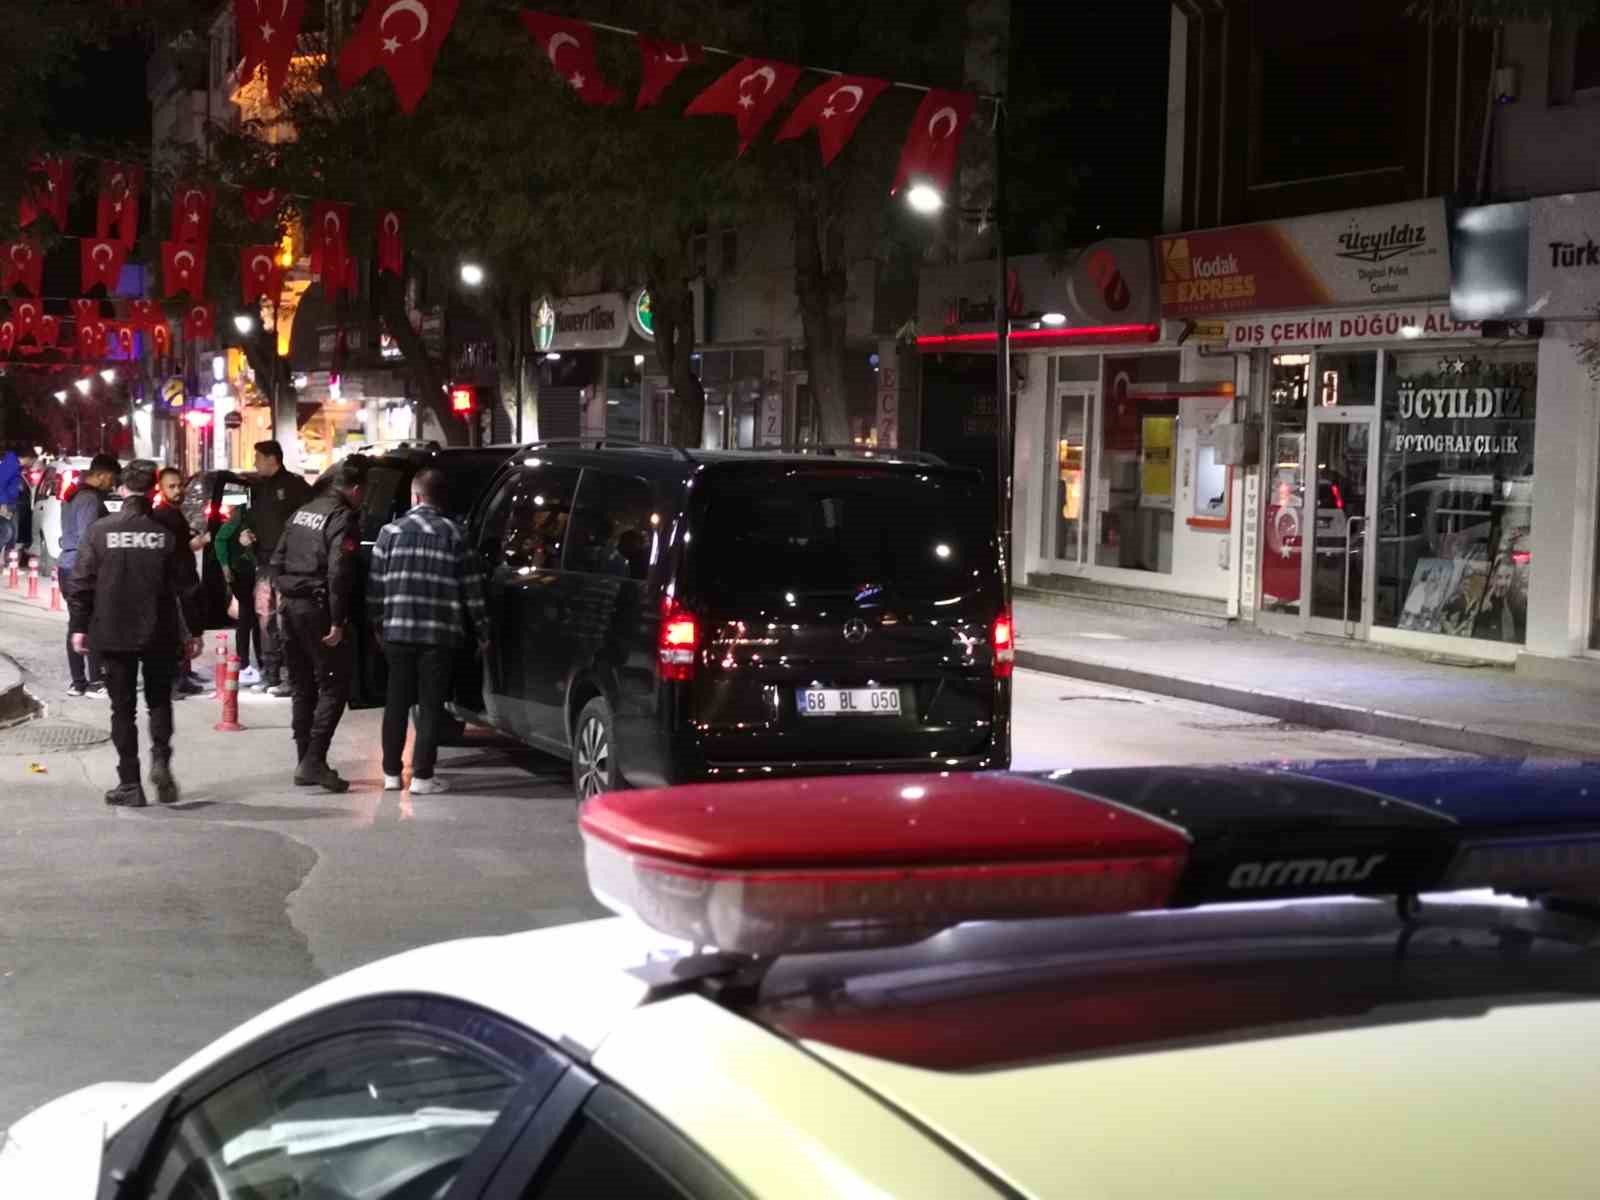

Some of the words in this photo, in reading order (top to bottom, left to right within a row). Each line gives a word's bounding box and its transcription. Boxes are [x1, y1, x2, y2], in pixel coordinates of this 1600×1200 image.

[1192, 253, 1239, 278] Kodak
[1178, 274, 1257, 301] EXPRESS
[1235, 323, 1265, 344] DIŞ
[1271, 319, 1332, 344] ÇEKİM
[1398, 383, 1522, 422] ÜÇYILDIZ
[1395, 434, 1519, 456] FOTOGRAFÇILIK
[106, 532, 166, 549] BEKÇİ
[807, 692, 825, 709] 68
[840, 691, 857, 709] BL
[871, 691, 898, 709] 050
[1229, 853, 1387, 888] armas
